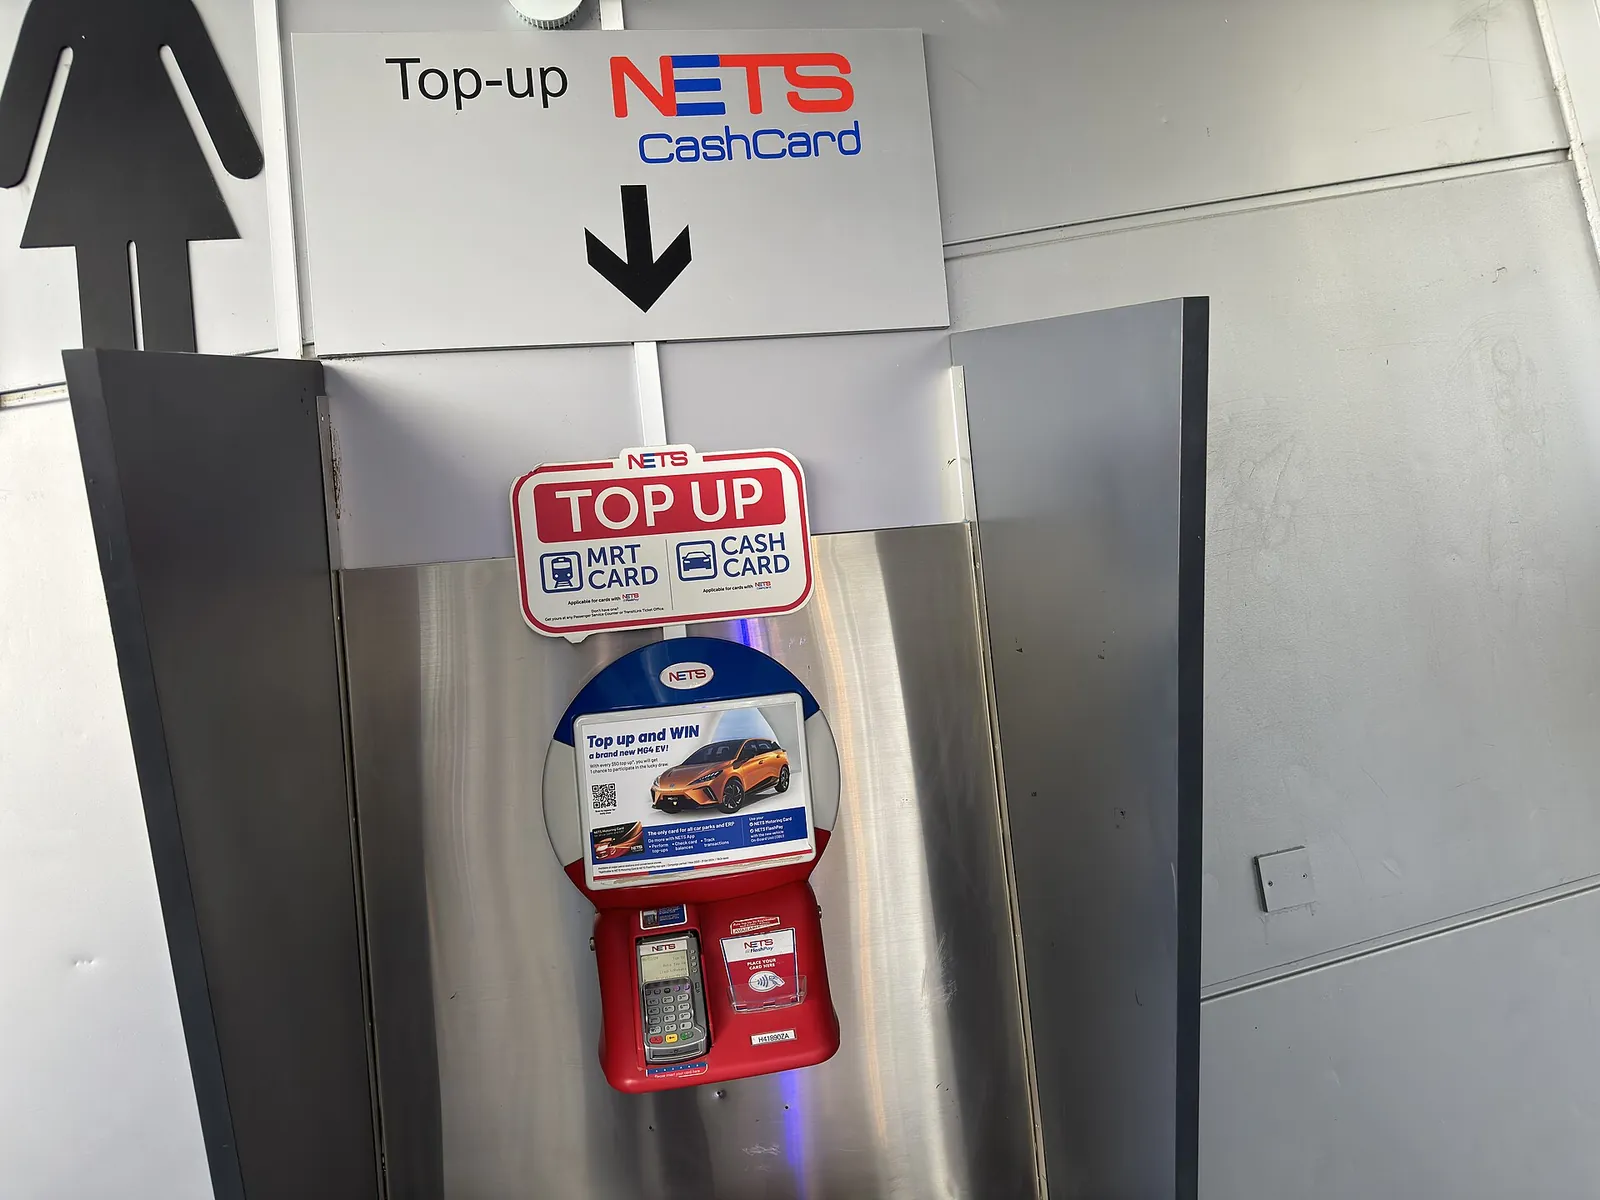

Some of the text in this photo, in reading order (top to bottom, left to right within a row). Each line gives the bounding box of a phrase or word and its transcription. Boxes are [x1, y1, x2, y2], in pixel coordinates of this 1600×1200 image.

[385, 52, 855, 118] Top-up NETS
[638, 120, 862, 164] CashCard
[627, 450, 689, 470] NETS
[555, 477, 763, 532] TOP UP
[721, 532, 786, 555] CASH
[587, 543, 641, 568] MRT
[723, 554, 790, 578] CARD
[587, 565, 659, 589] CARD
[668, 668, 707, 682] NETS
[587, 724, 700, 749] Top up and WIN
[595, 750, 618, 759] brand
[619, 749, 636, 757] new
[637, 747, 654, 755] MG4
[612, 765, 635, 773] participate
[702, 824, 716, 832] parks
[703, 840, 730, 848] transactions
[652, 944, 676, 952] NETS
[743, 938, 774, 949] NETS
